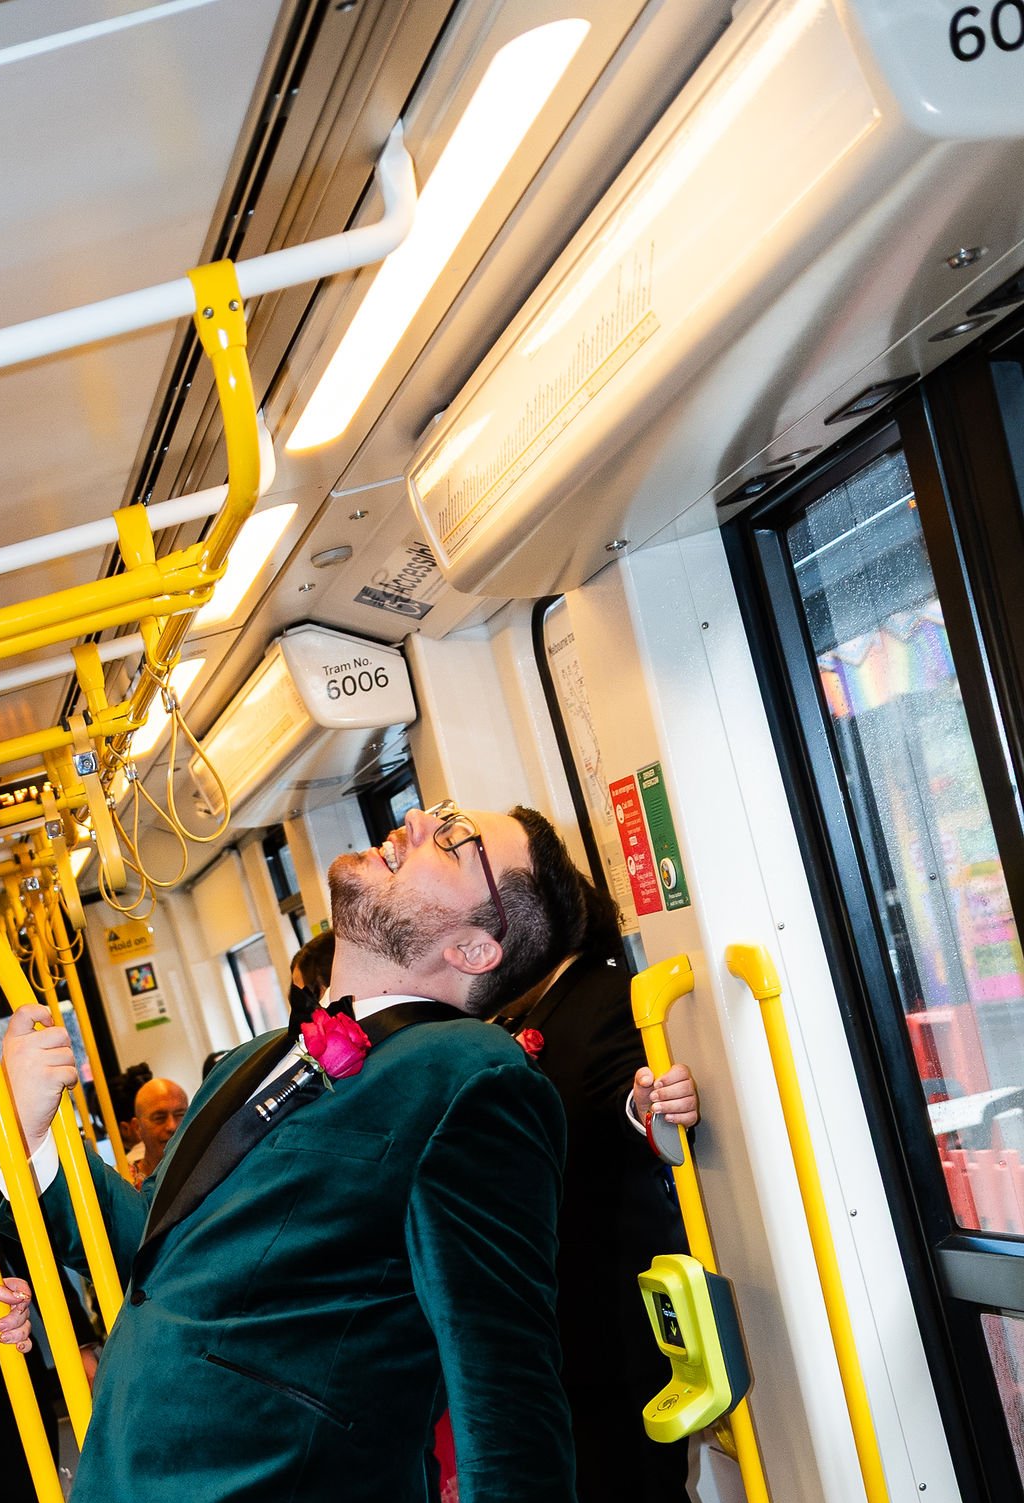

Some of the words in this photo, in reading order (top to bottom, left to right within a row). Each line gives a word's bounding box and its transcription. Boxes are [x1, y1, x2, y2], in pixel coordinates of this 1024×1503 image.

[322, 664, 352, 676] Tram
[353, 657, 373, 668] No.
[327, 667, 389, 700] 6006
